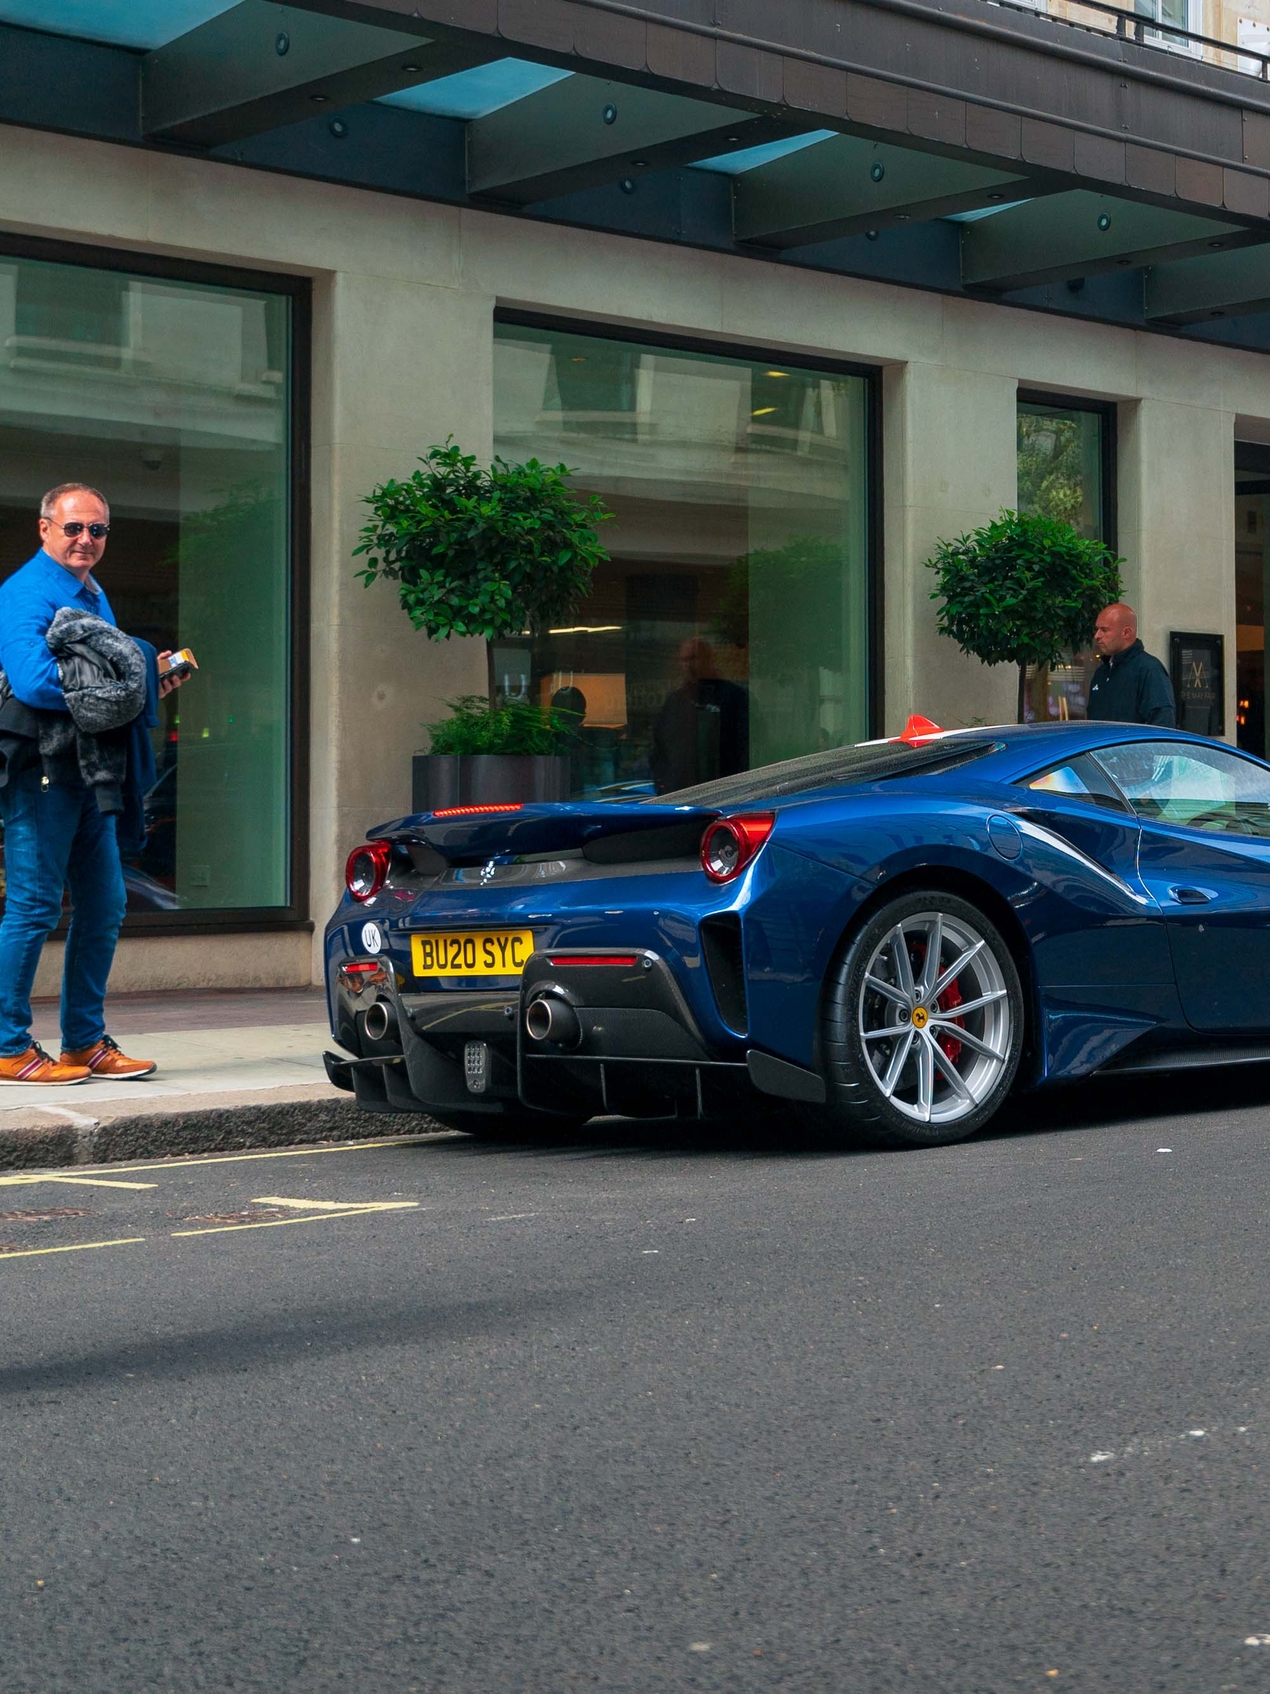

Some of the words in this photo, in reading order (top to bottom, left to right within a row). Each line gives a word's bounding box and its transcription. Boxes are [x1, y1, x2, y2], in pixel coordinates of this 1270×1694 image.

[364, 929, 378, 948] UK
[420, 938, 476, 970] BU20
[483, 936, 525, 969] SYC
